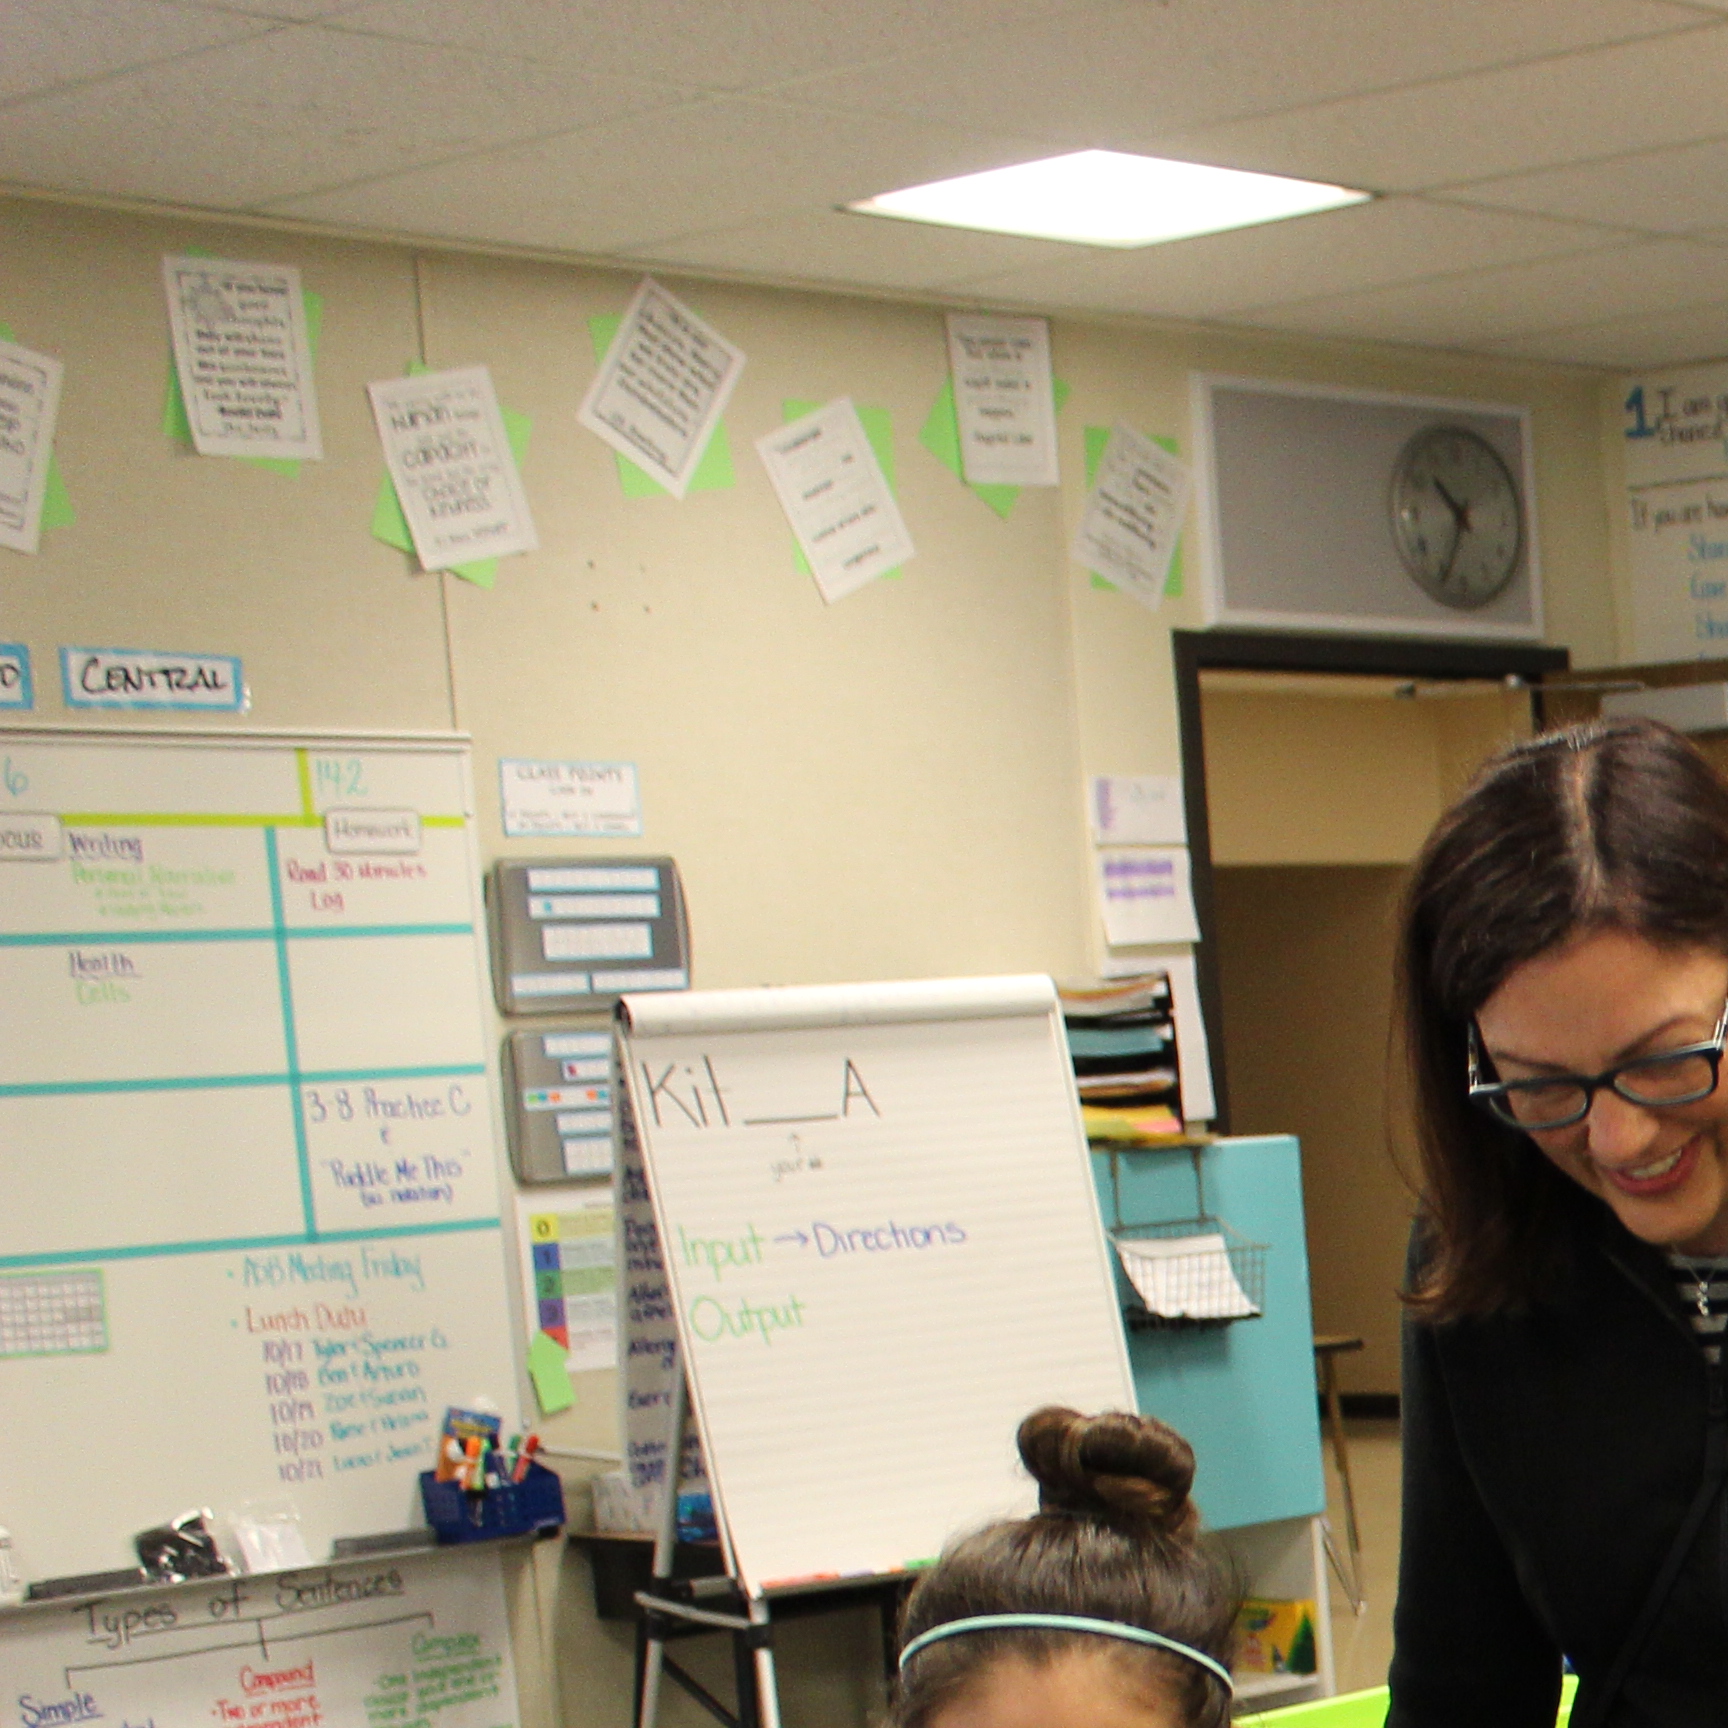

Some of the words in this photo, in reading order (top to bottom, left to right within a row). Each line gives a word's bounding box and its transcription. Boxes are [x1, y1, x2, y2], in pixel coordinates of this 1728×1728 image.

[80, 655, 229, 695] CENTRAL
[68, 831, 144, 864] Writing
[841, 1056, 883, 1119] A
[677, 1221, 765, 1283] Input
[810, 1219, 968, 1259] Directions
[245, 1306, 312, 1334] Lunch
[689, 1293, 807, 1347] Output
[71, 1600, 179, 1651] Types
[207, 1577, 250, 1620] of
[276, 1567, 406, 1612] Sentences
[18, 1690, 98, 1728] Simple
